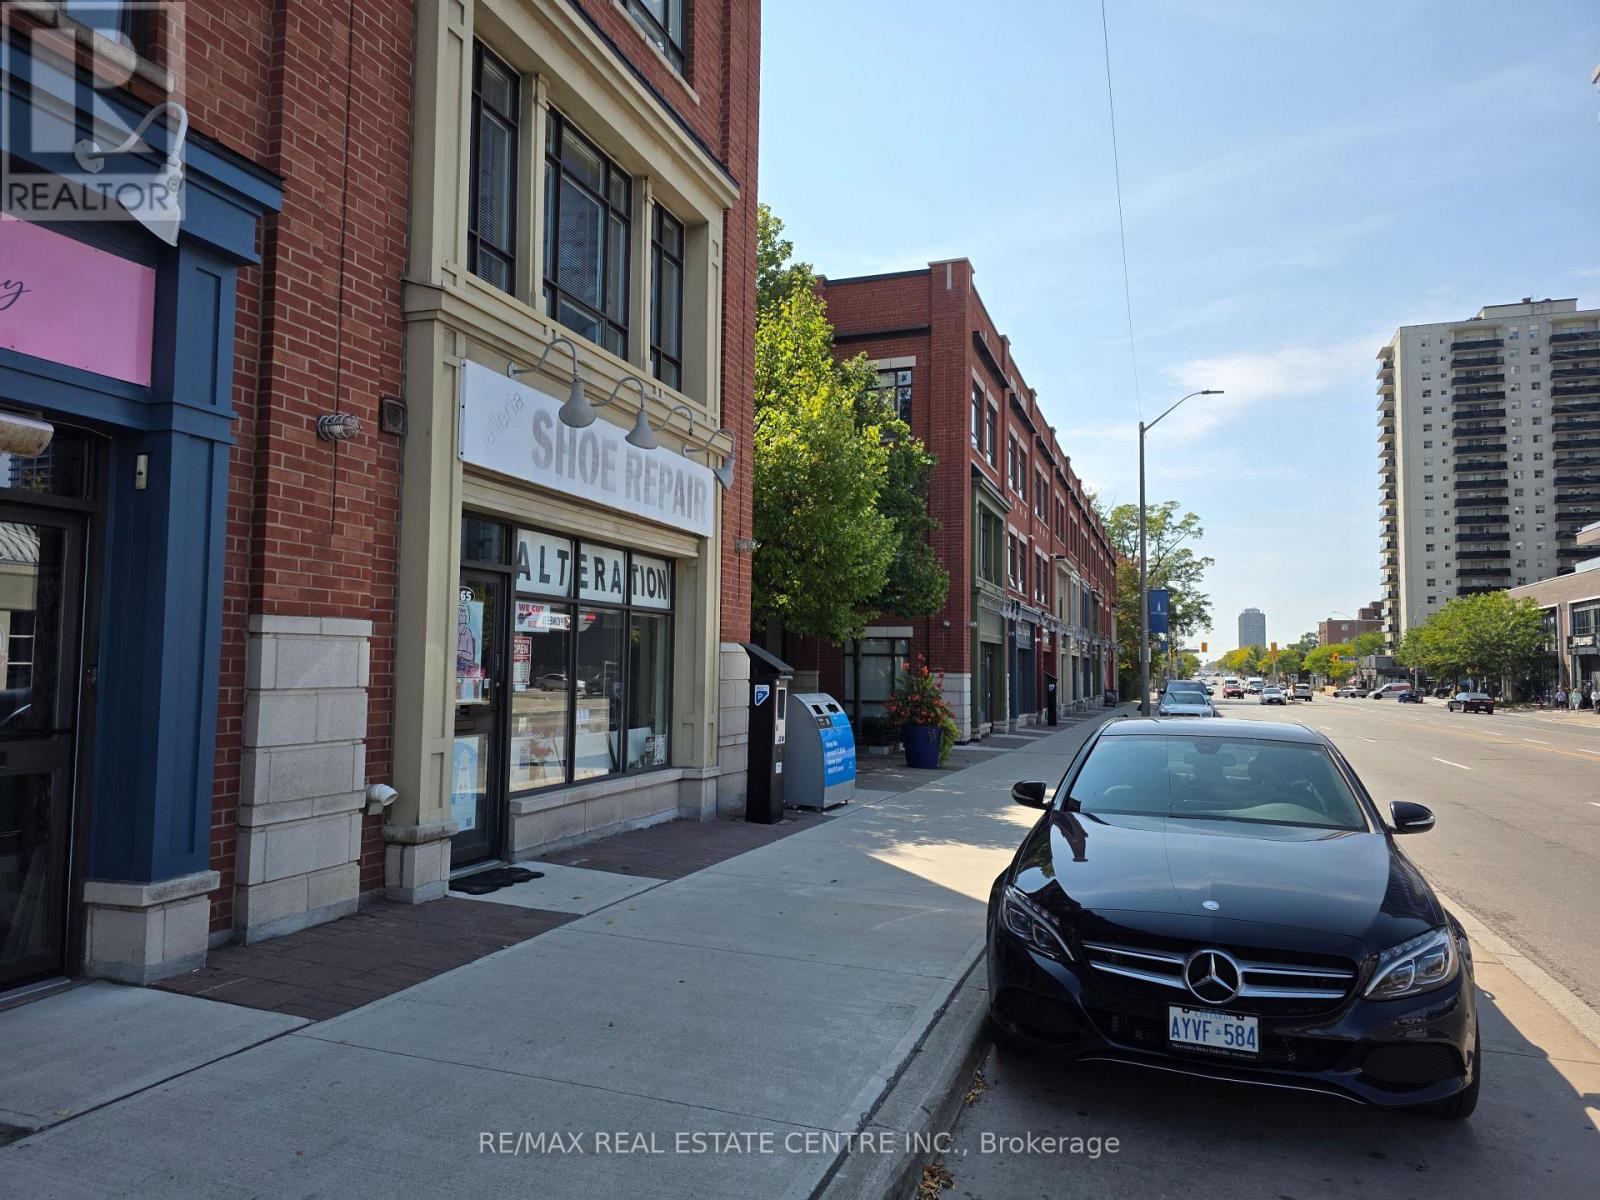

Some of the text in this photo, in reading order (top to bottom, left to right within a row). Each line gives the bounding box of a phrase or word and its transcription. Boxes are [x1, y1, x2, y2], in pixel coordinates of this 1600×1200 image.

[484, 391, 524, 447] alleria
[532, 408, 707, 524] SHOE REPAIR
[516, 541, 667, 600] ALTERATION
[518, 603, 530, 611] WE
[1171, 1016, 1256, 1049] AYVF 584
